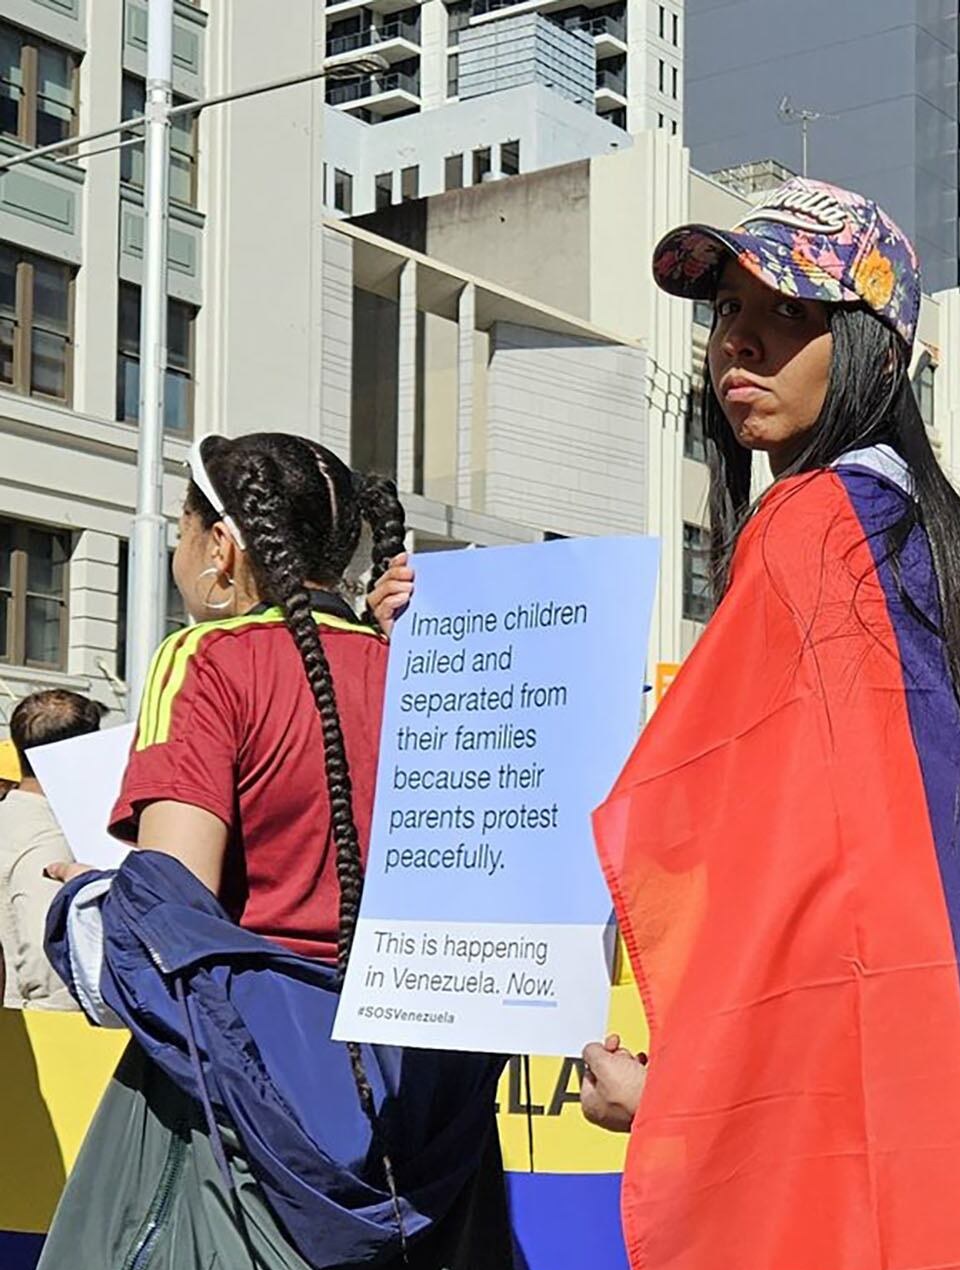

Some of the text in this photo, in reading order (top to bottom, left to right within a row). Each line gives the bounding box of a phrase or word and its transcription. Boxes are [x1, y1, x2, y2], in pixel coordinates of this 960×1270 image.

[411, 601, 588, 641] Imagine children
[402, 645, 513, 681] jailed and
[400, 682, 568, 718] separated from
[396, 724, 538, 751] their families
[393, 762, 545, 791] because their
[389, 803, 559, 836] parents protest
[384, 843, 506, 876] peacefully.
[374, 931, 549, 966] This is happening
[364, 965, 556, 997] in Venezuela. Now.
[357, 1006, 456, 1025] #SOSVenezuela
